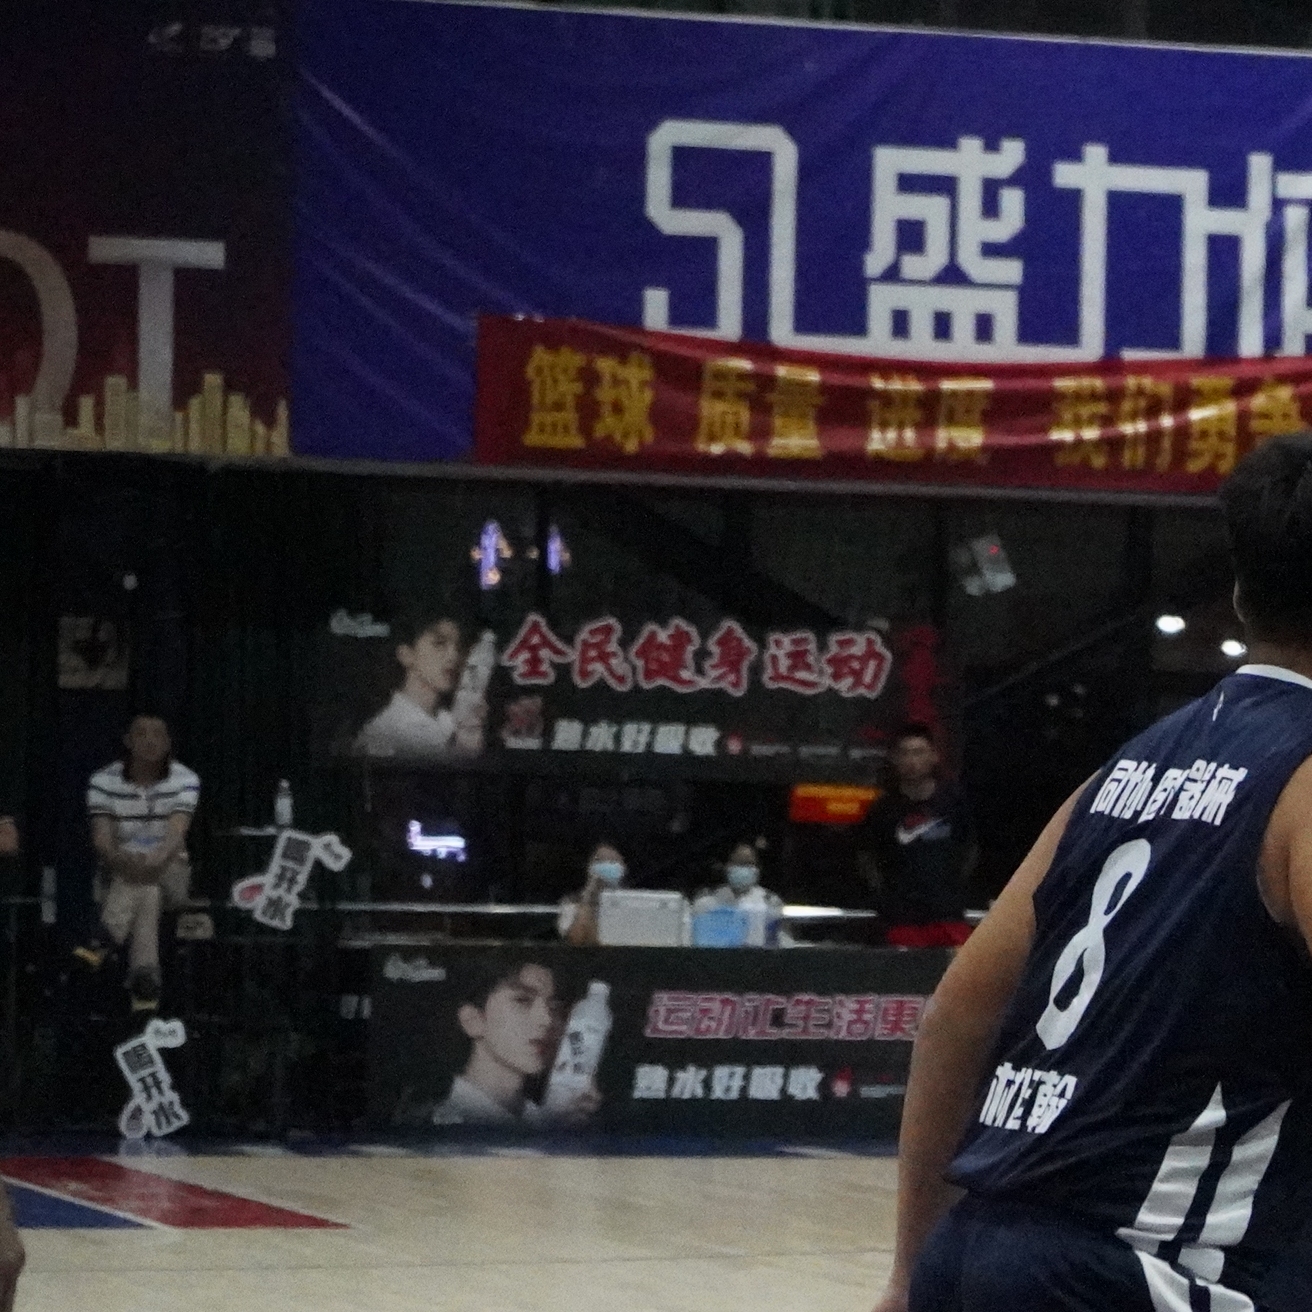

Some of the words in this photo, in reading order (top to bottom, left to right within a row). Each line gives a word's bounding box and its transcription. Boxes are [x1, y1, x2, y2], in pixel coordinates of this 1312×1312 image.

[521, 346, 655, 455] 篮球
[697, 356, 825, 460] 质量
[501, 612, 893, 697] 全民健身运动
[1036, 838, 1151, 1051] 8
